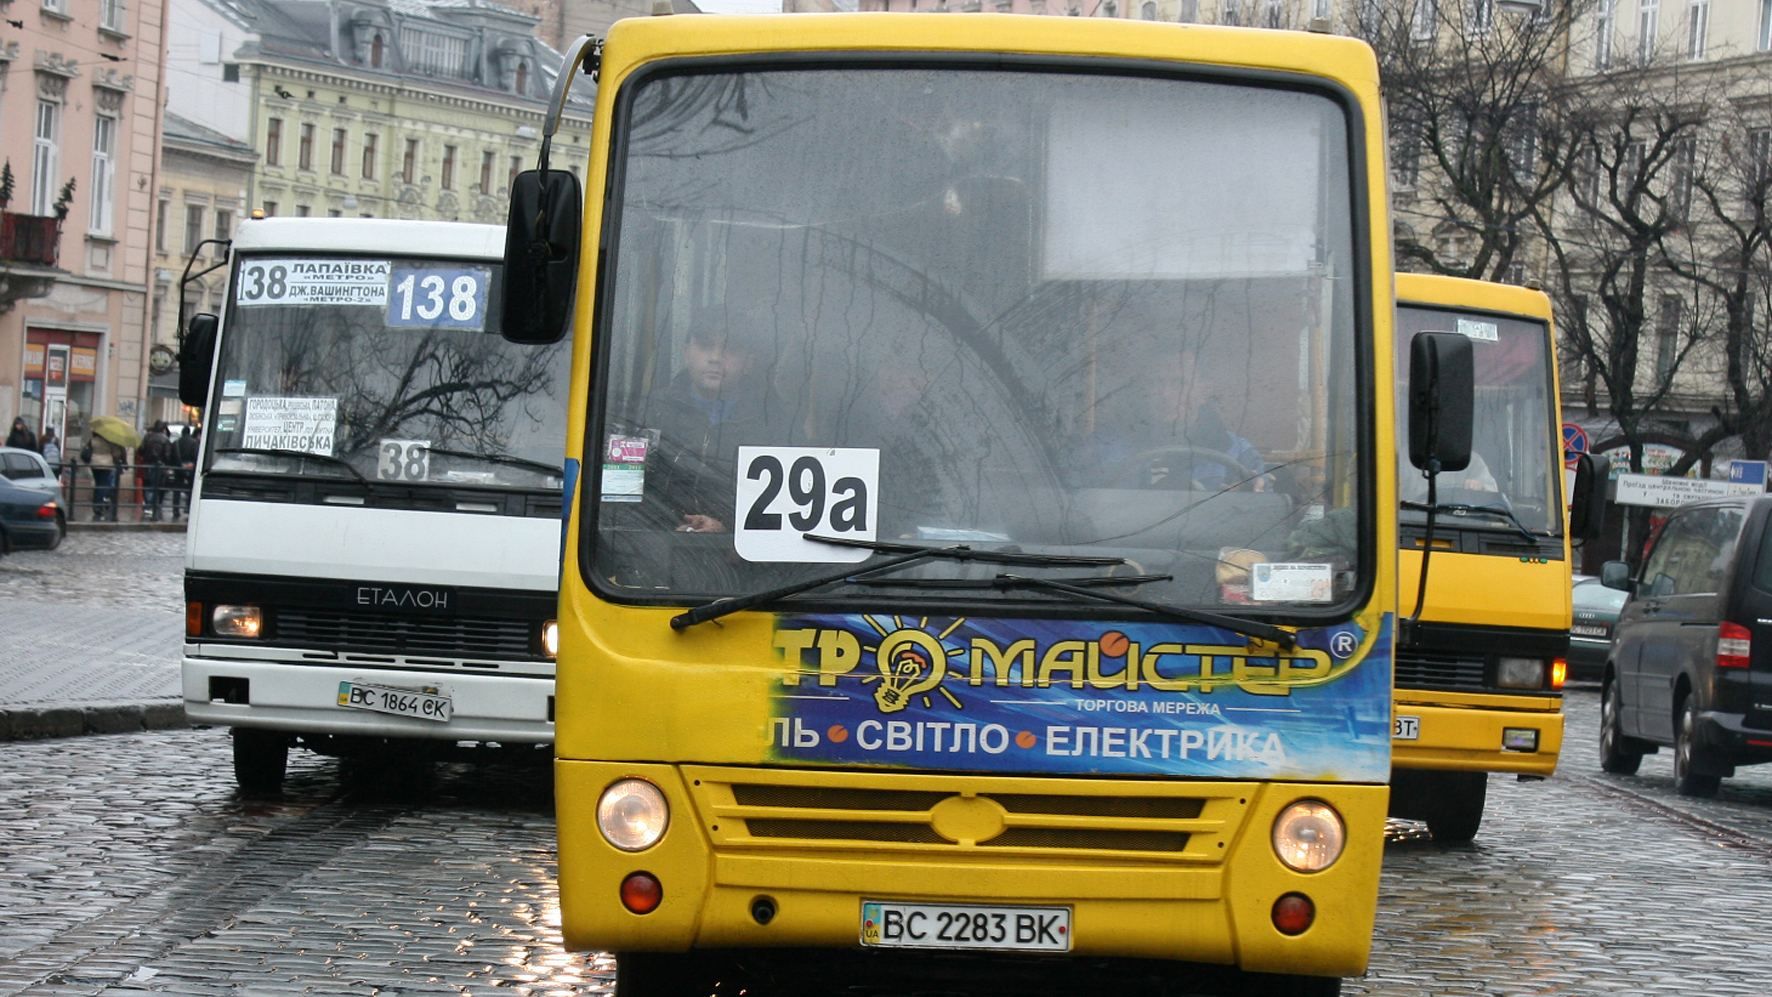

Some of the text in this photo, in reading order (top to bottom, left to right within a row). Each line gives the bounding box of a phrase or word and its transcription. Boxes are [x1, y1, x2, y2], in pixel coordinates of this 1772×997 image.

[291, 262, 387, 274] ЛАПАЇВКА
[289, 285, 385, 298] ДЖ.ВАШИНГТОНА
[397, 275, 477, 321] 138
[381, 442, 427, 480] 38
[357, 587, 448, 609] ЕТАЛОН
[350, 687, 448, 719] BC 1864 CK
[1076, 698, 1222, 716] ТОРГОВА МЕРЕЖА
[856, 719, 1010, 754] СВІТЛО
[1046, 725, 1287, 763] ЕЛЕКТРИКА
[883, 910, 1061, 944] BC 2283 BK
